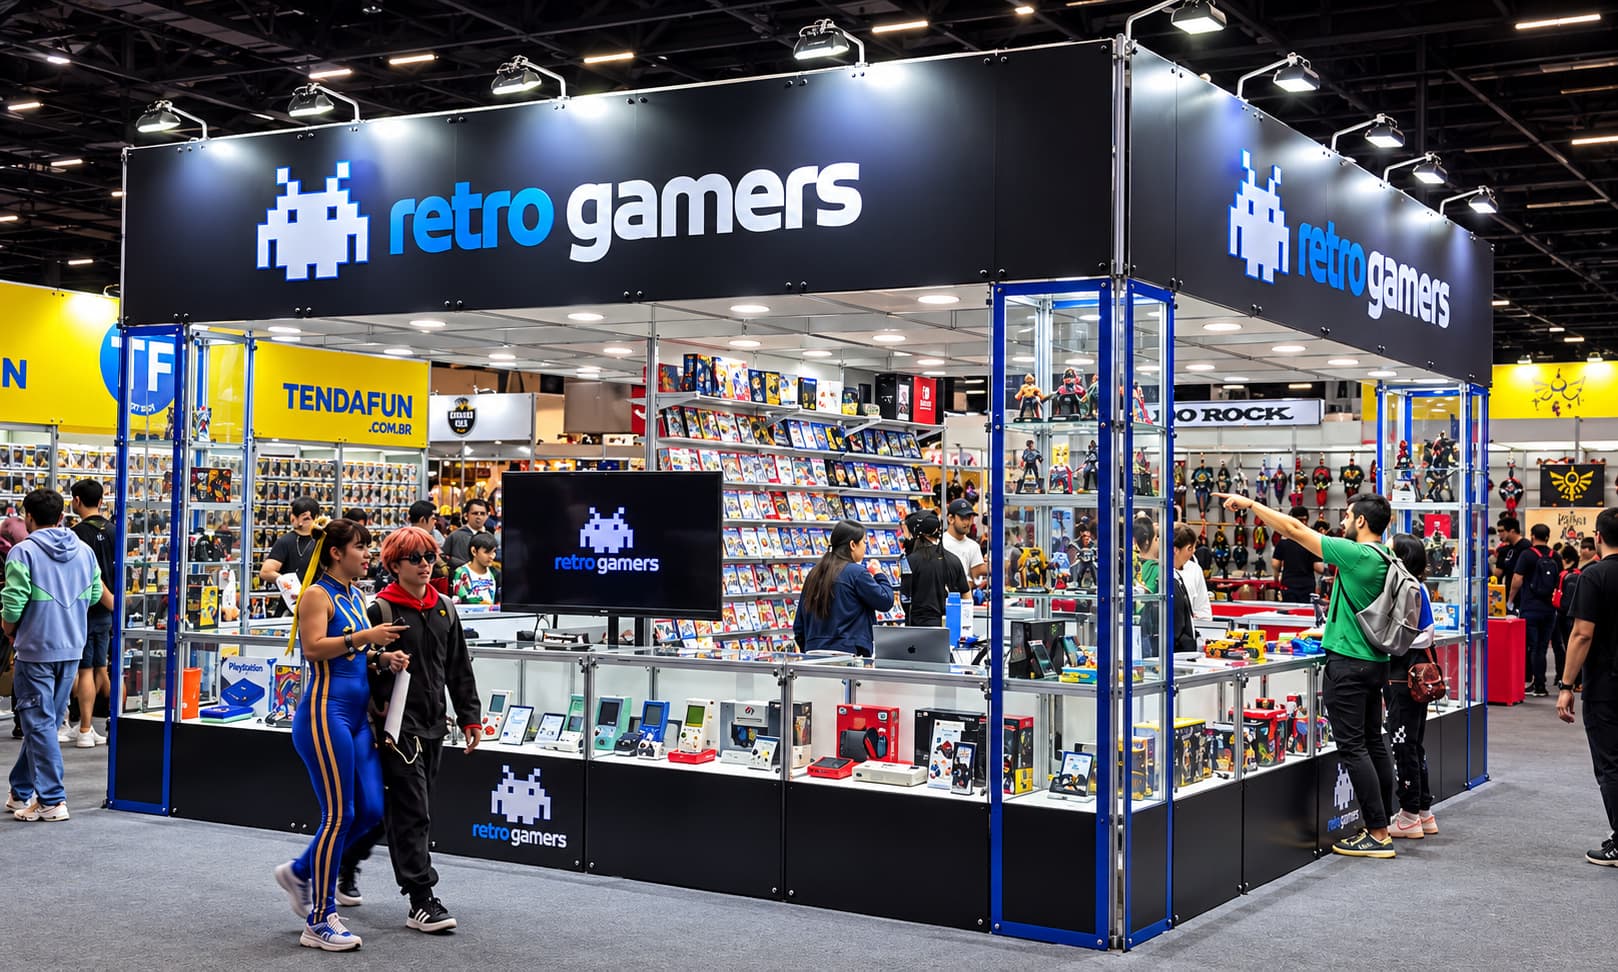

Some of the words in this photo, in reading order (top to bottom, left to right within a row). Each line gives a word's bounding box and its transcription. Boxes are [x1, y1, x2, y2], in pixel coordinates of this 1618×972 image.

[389, 181, 555, 255] retro
[566, 162, 863, 263] gamers
[1298, 220, 1367, 297] retro
[1367, 250, 1451, 329] gamers
[111, 335, 175, 392] TF
[282, 382, 413, 419] TENDAFUN
[1201, 406, 1294, 422] ROCK
[368, 421, 412, 435] .COM.BR
[554, 554, 596, 570] retro
[597, 557, 660, 575] gamers
[472, 822, 510, 841] retro
[511, 828, 567, 848] gamers
